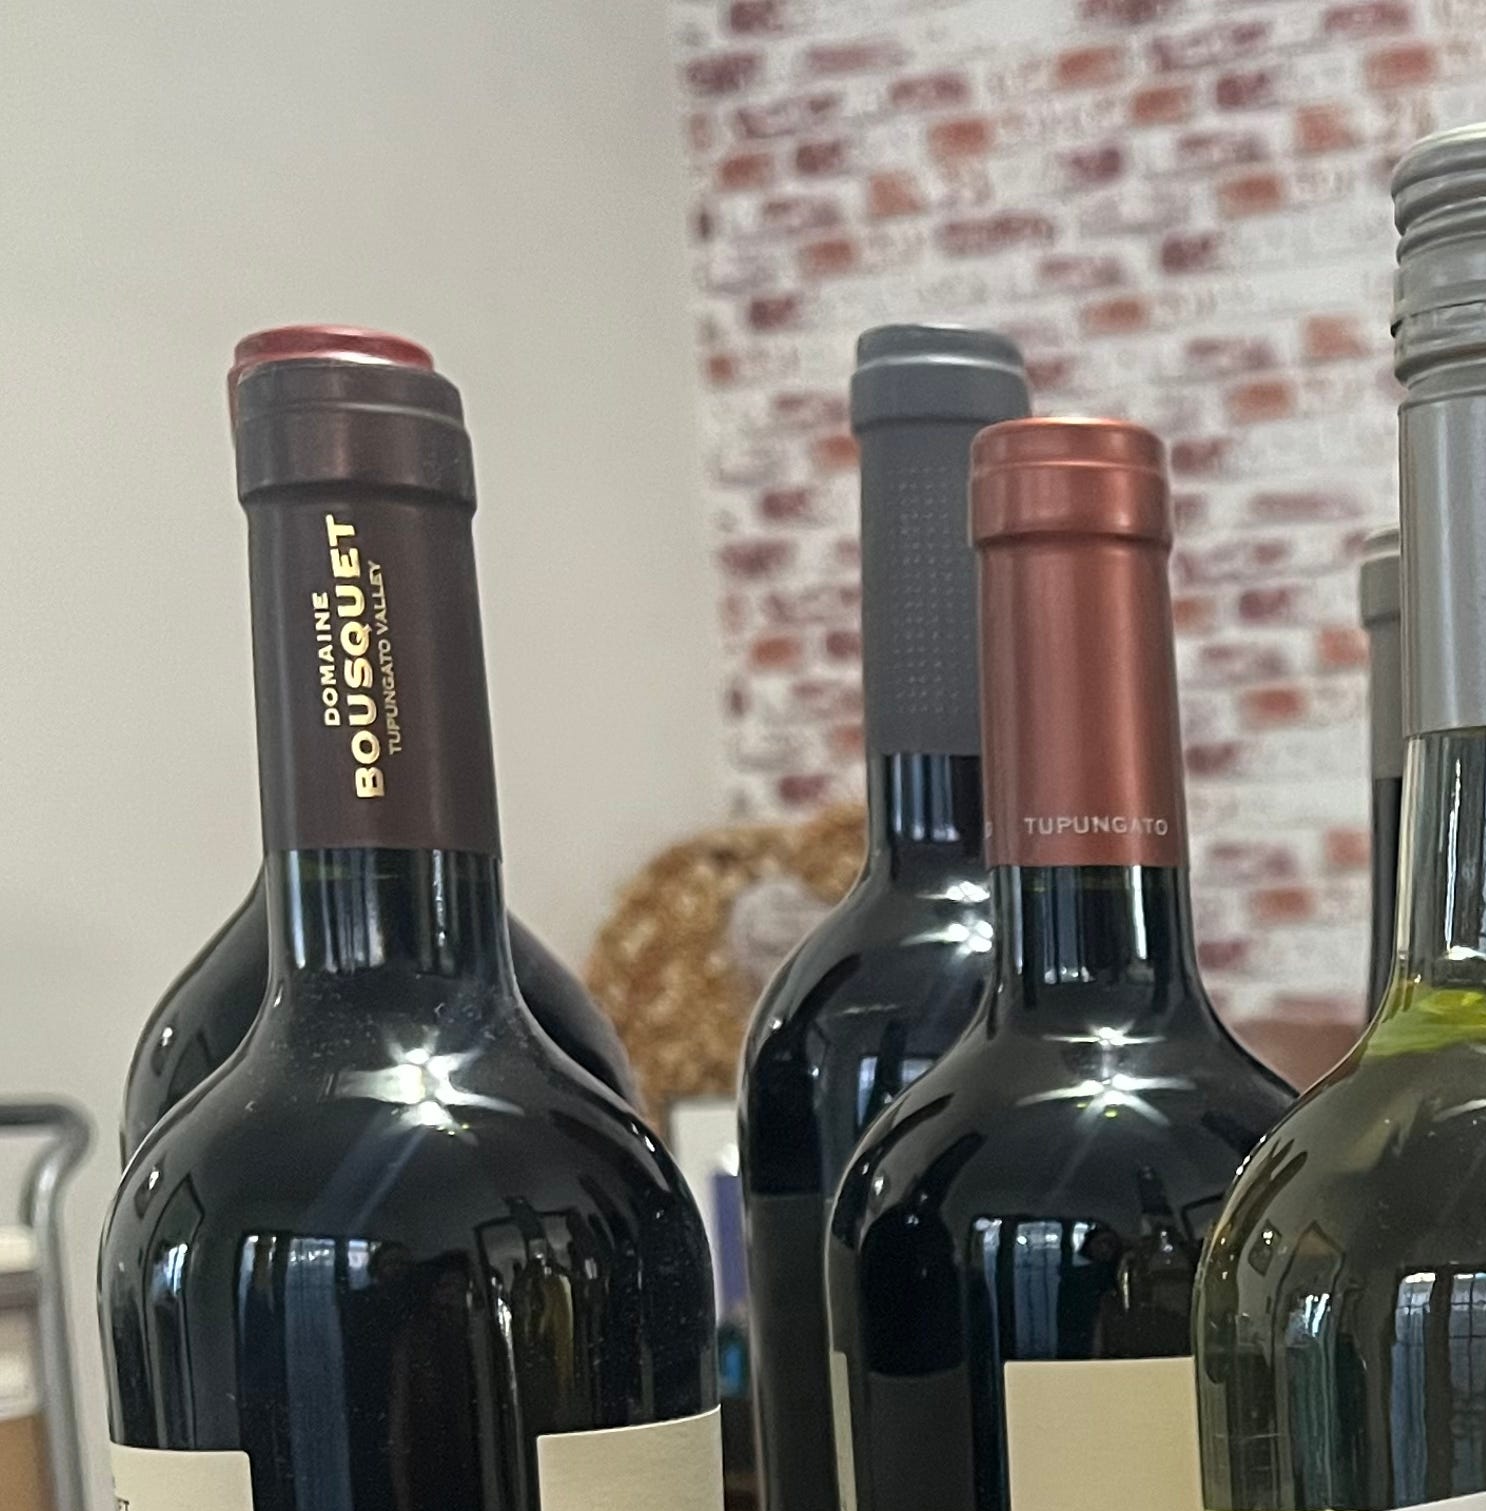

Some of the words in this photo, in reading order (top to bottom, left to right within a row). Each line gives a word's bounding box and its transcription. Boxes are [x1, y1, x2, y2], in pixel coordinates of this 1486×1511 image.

[325, 513, 385, 798] BOUSQUET
[368, 560, 390, 636] VALLEY
[311, 592, 341, 727] DOMAINE
[378, 638, 402, 755] TUPUNGATO
[1023, 815, 1169, 836] TUPUNGATO
